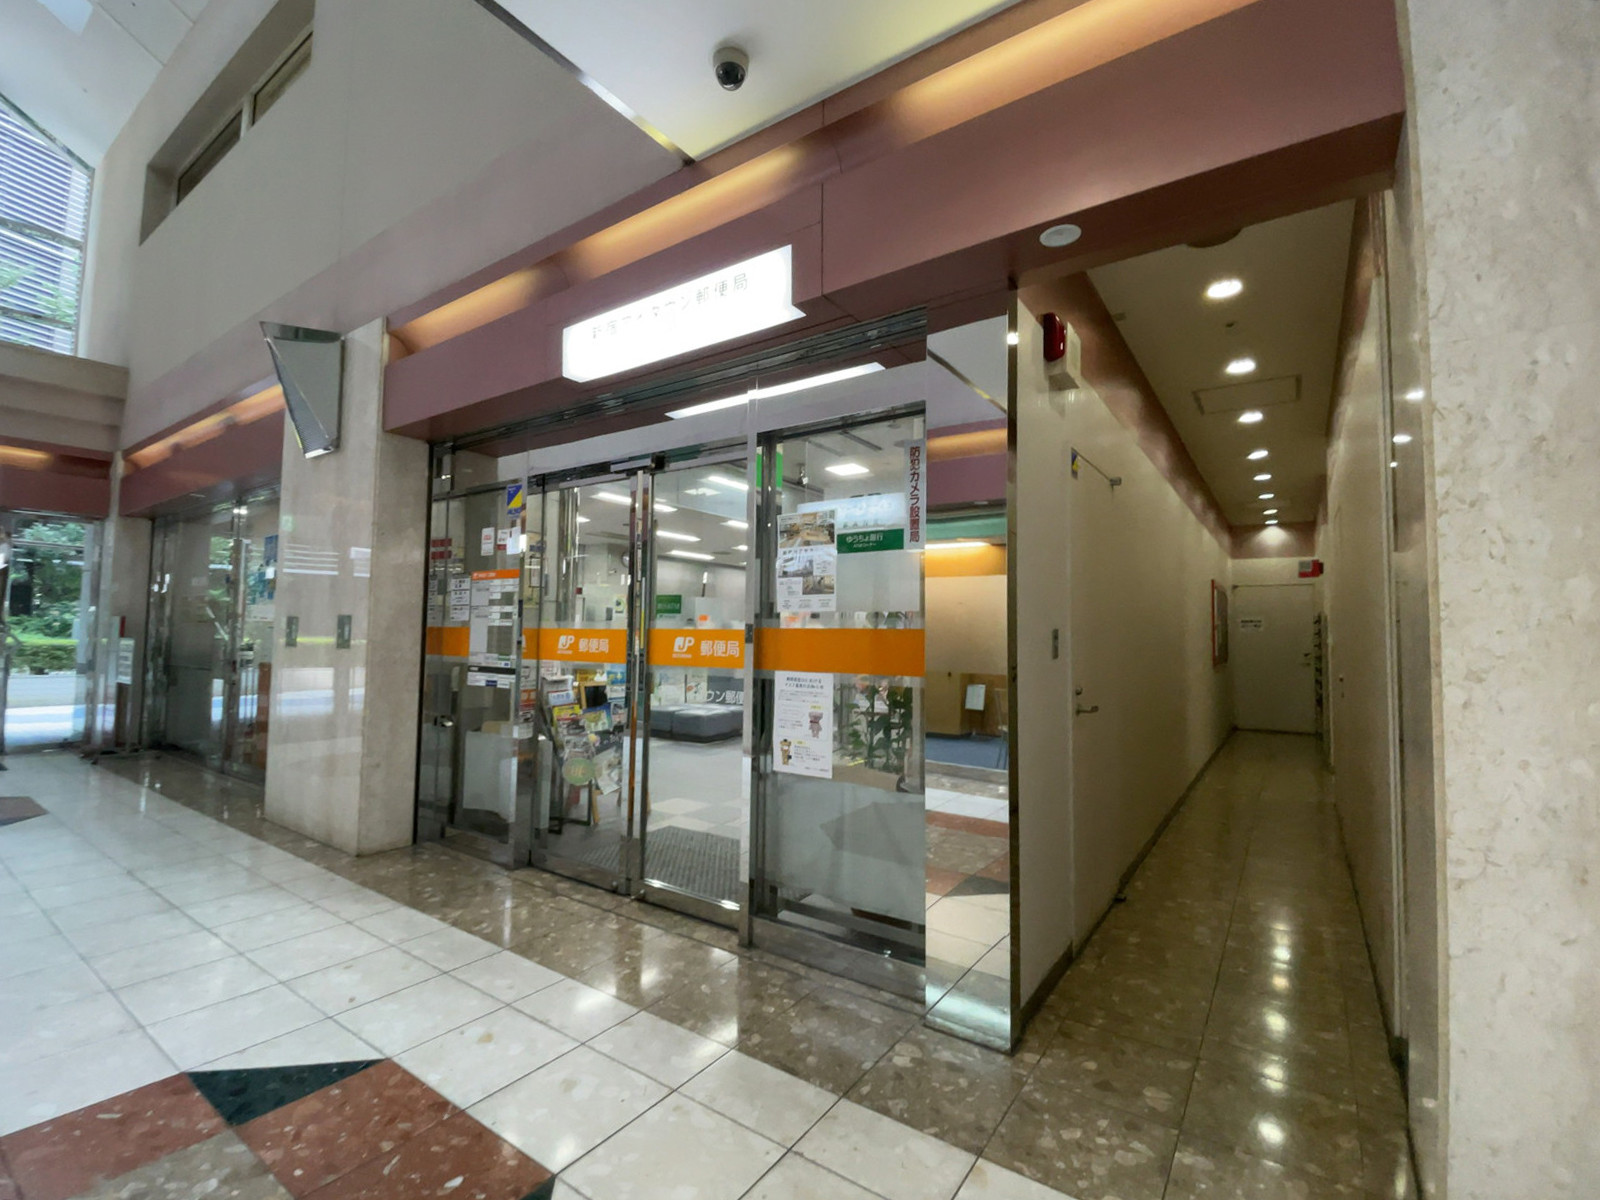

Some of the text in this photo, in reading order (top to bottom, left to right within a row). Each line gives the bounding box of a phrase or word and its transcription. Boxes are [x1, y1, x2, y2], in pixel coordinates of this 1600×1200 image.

[592, 272, 748, 341] 宿ン郵便局
[910, 446, 920, 542] 防犯カメラ設置局
[846, 533, 884, 543] ゆうちょ銀行
[578, 638, 609, 653] 郵便局
[700, 640, 740, 657] 郵便局
